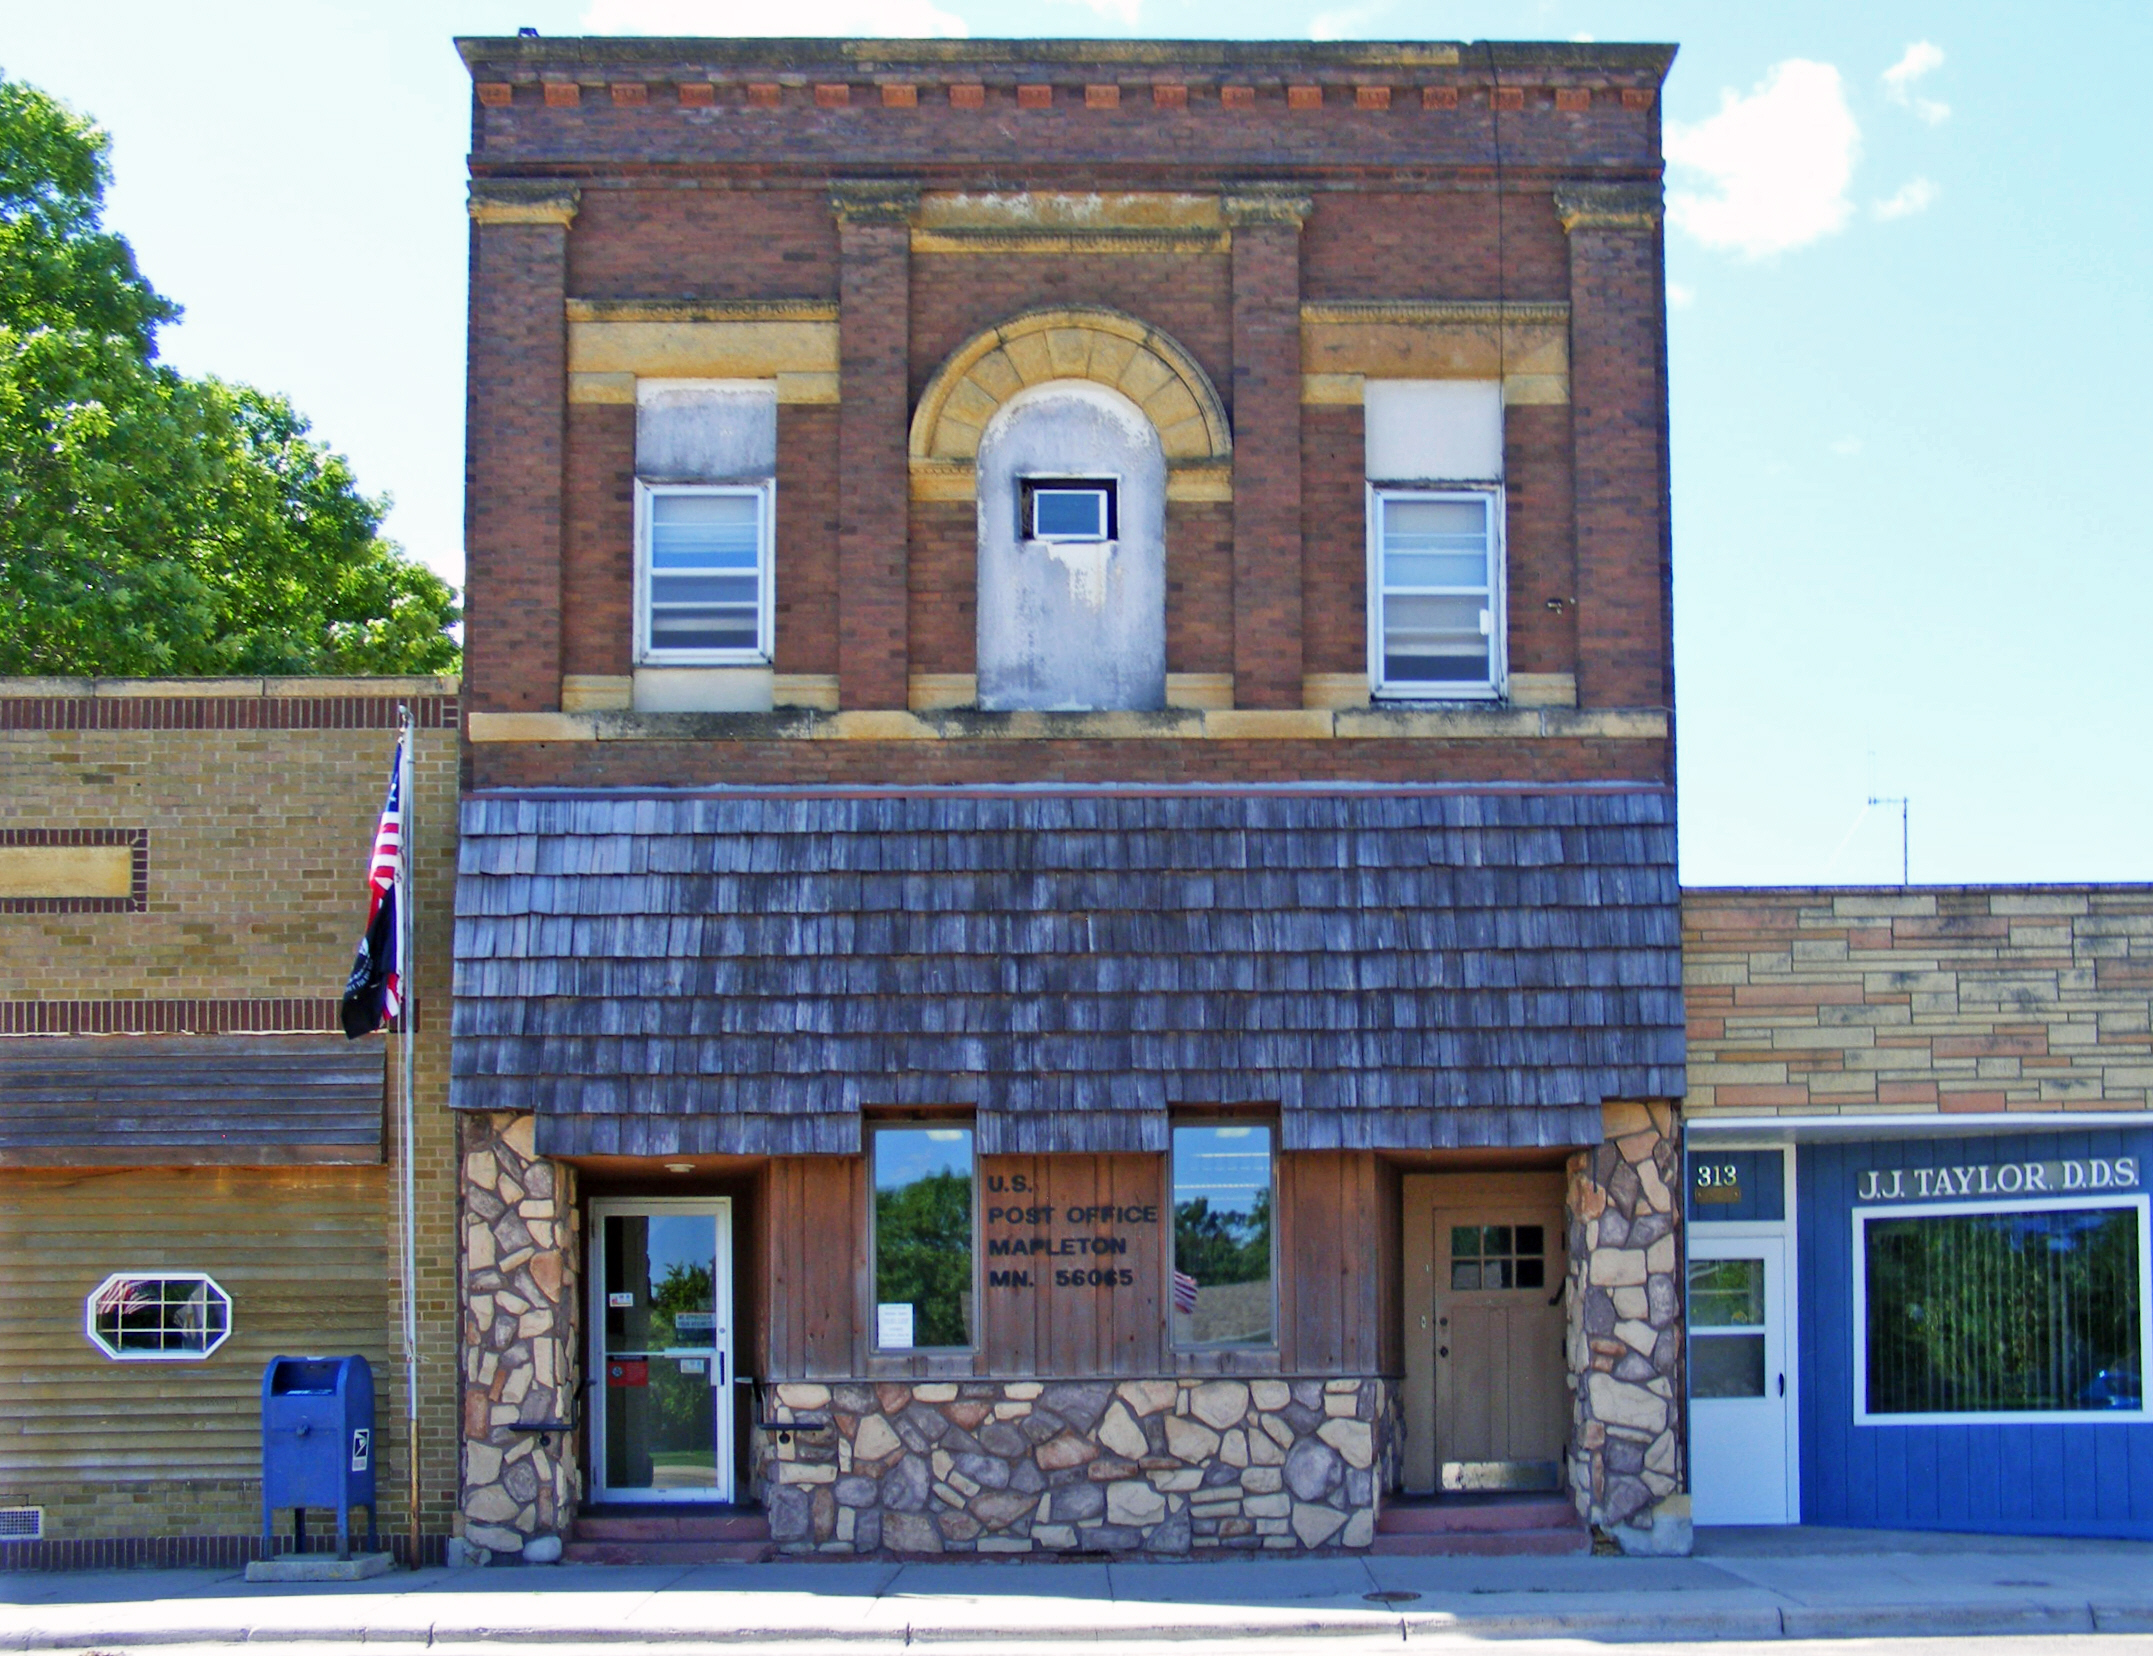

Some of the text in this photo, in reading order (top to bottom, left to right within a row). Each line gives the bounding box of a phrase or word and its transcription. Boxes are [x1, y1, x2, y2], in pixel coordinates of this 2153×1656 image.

[987, 1175, 1033, 1193] U.S.
[1697, 1165, 1737, 1187] 313
[1858, 1170, 1905, 1200] J.J.
[2062, 1157, 2140, 1188] D.D.S.
[988, 1205, 1158, 1224] POST OFFICE
[988, 1238, 1127, 1256] MAPLETON
[989, 1269, 1134, 1287] MN. 56065
